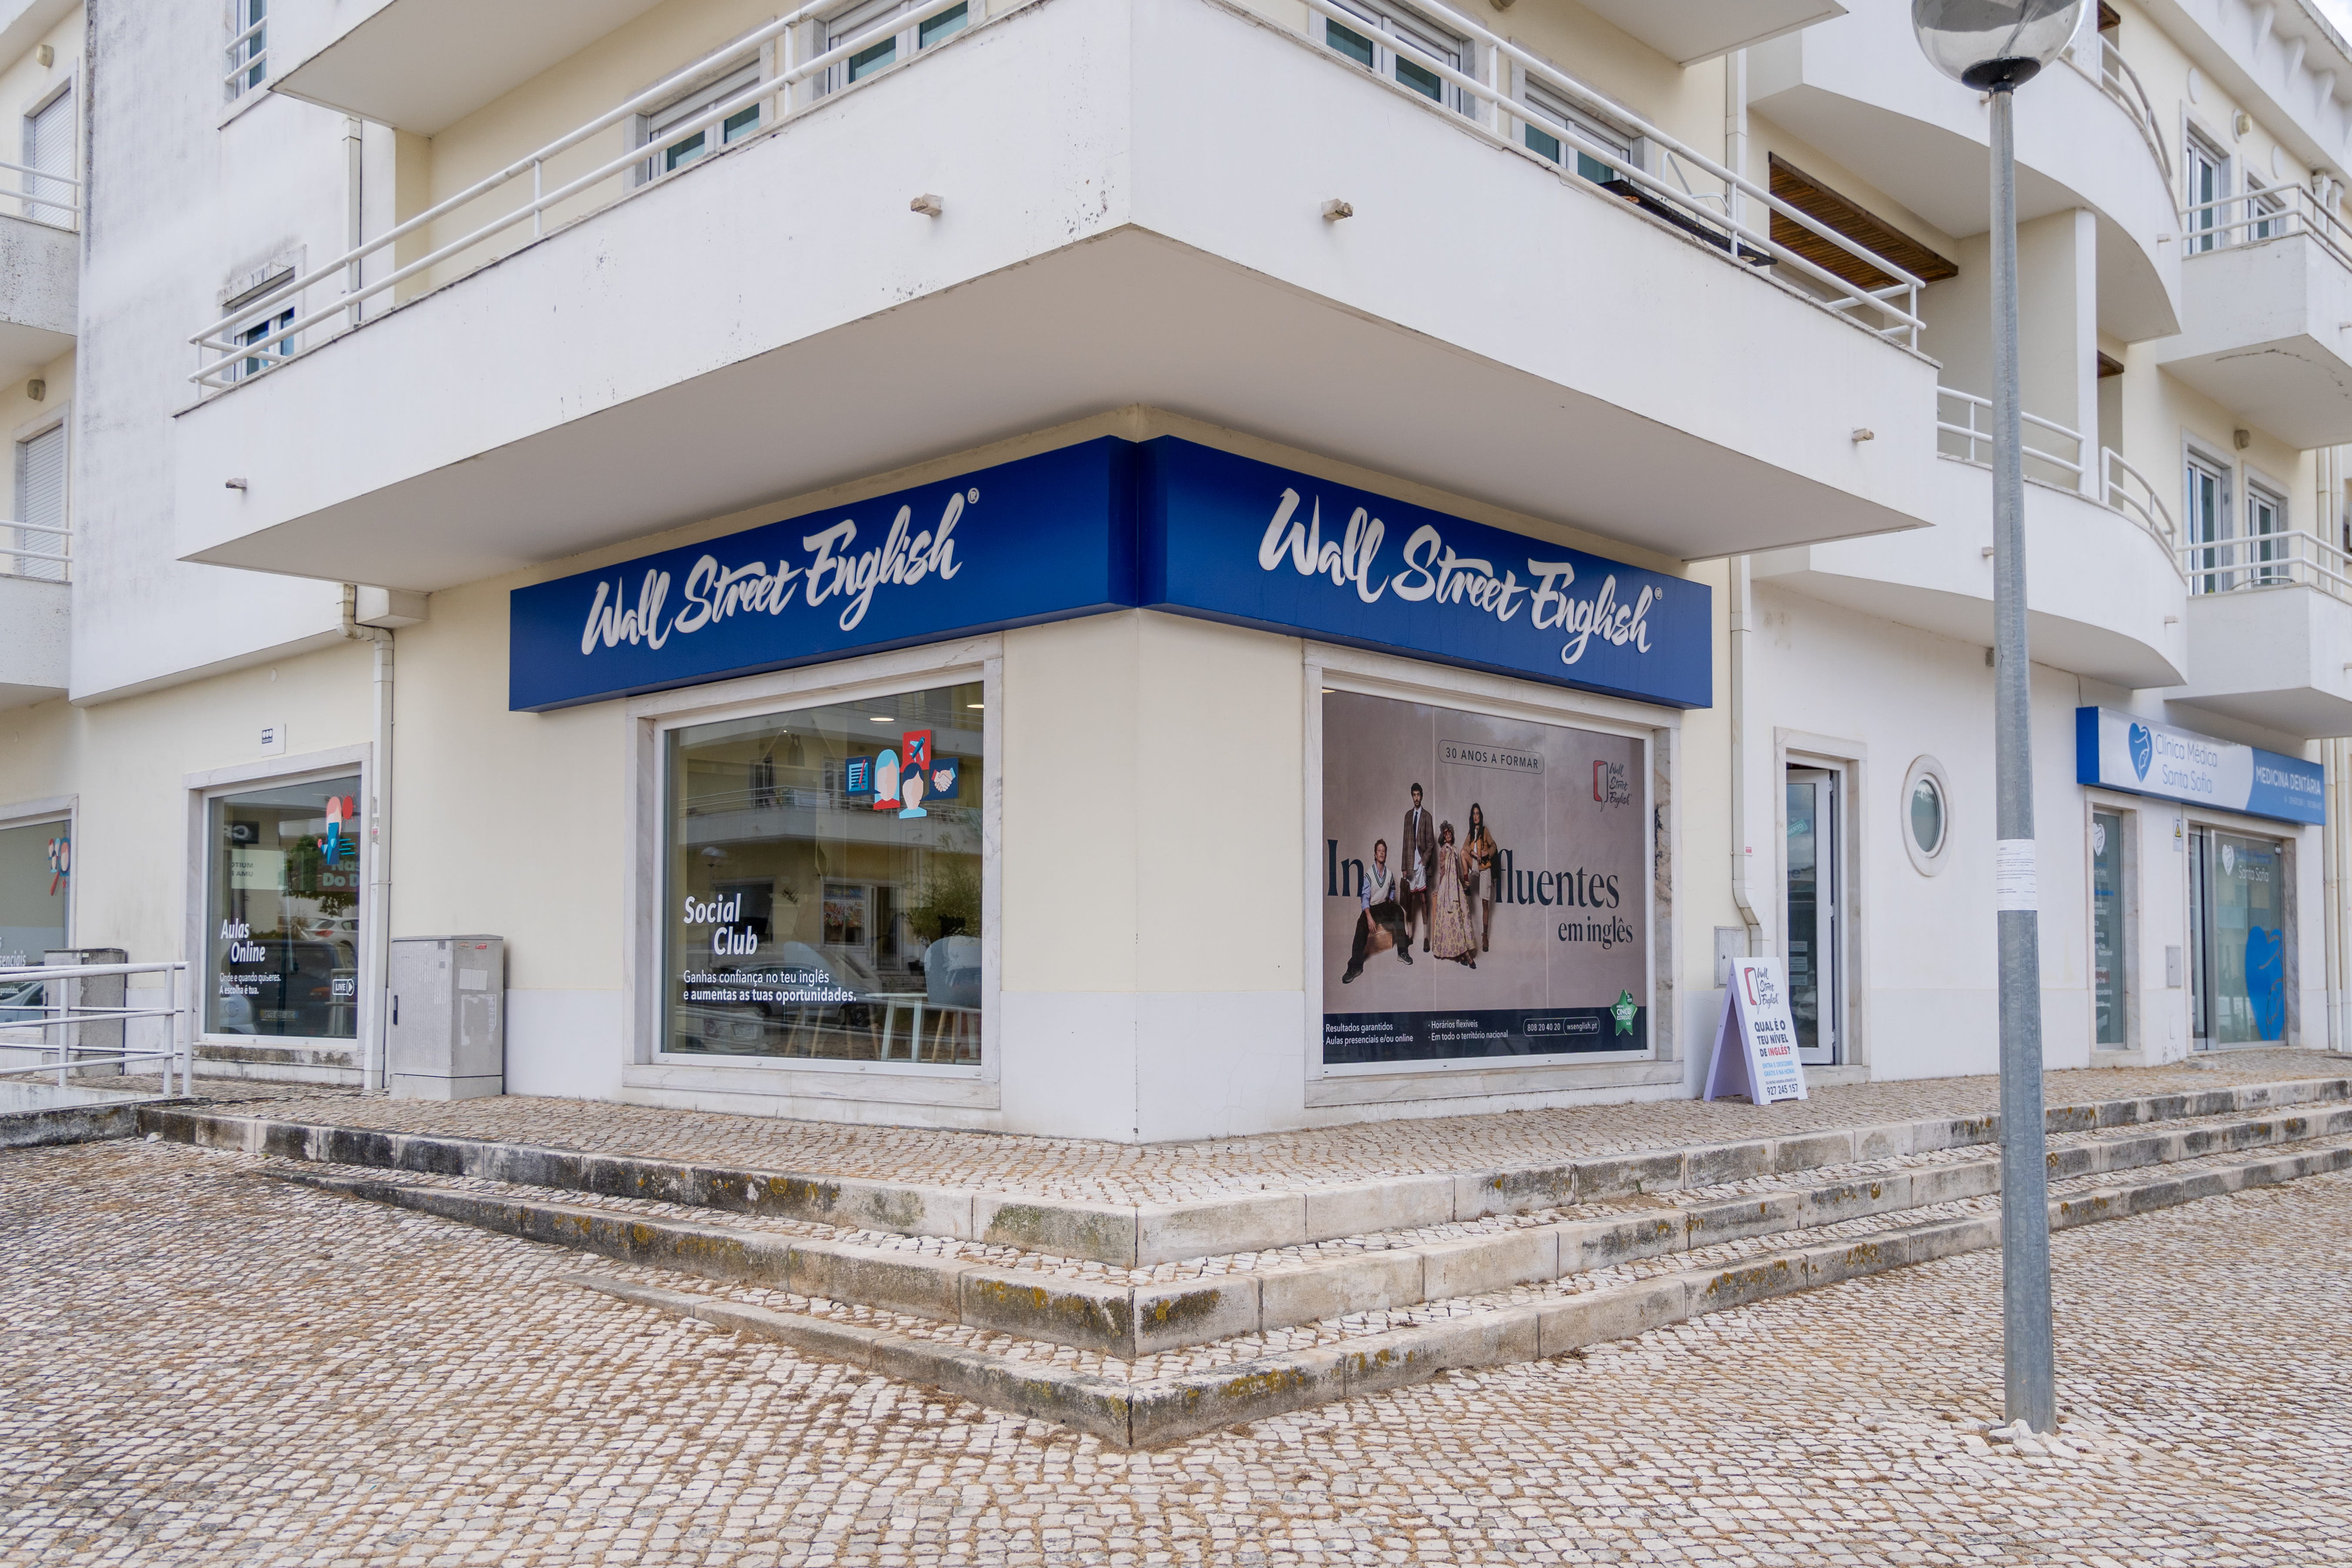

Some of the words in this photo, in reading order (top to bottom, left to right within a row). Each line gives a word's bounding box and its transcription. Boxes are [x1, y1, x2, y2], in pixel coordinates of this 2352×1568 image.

[1258, 487, 1389, 603] Wall
[1391, 524, 1530, 622] Street
[581, 569, 674, 655] Wall
[674, 554, 805, 634] Street
[1446, 747, 1457, 759] 30
[1461, 750, 1487, 763] ANOS
[1491, 754, 1497, 764] A
[1501, 755, 1538, 769] FORMAR
[2155, 734, 2185, 759] Clínica
[2187, 741, 2217, 767] Médica
[1609, 762, 1624, 777] Wall
[1609, 776, 1628, 791] Street
[2162, 764, 2188, 789] Santa
[2191, 770, 2212, 794] Sofia
[2255, 765, 2289, 788] MEDICINA
[2290, 774, 2321, 795] DENTÁRIA
[1787, 823, 1803, 836] BERTO
[323, 873, 346, 887] Do
[1327, 839, 1364, 897] In
[1495, 848, 1619, 908] fluentes
[2239, 865, 2254, 880] Santa
[2255, 867, 2269, 882] Sofia
[684, 893, 741, 924] Social
[220, 918, 250, 939] Aulas
[1558, 921, 1583, 942] em
[1587, 915, 1633, 950] inglês
[714, 925, 757, 955] Club
[231, 941, 266, 963] Online
[220, 972, 234, 982] Onde
[238, 971, 257, 984] quando
[683, 969, 717, 984] Ganhas
[719, 969, 763, 986] confiança
[766, 974, 778, 984] no
[781, 971, 796, 984] teu
[799, 969, 829, 987] inglês
[1757, 967, 1768, 979] Wall
[219, 985, 224, 994] A
[224, 984, 244, 994] escolha
[244, 984, 248, 994] é
[249, 985, 259, 994] tua.
[1760, 980, 1774, 992] Street
[684, 991, 689, 1000] e
[691, 989, 737, 1001] aumentas
[739, 990, 750, 1001] as
[752, 988, 773, 1001] tuas
[776, 987, 857, 1004] oportunidades.
[1326, 1023, 1360, 1032] Resultados
[1361, 1022, 1393, 1033] garantidos
[1431, 1020, 1455, 1029] Horários
[1456, 1020, 1478, 1028] flexíveis
[1567, 1022, 1597, 1031] wsenglish.pt
[1755, 1021, 1774, 1032] QUAL
[1775, 1018, 1779, 1031] É
[1780, 1020, 1785, 1030] O
[1326, 1036, 1343, 1045] Aulas
[1344, 1035, 1378, 1046] presenciais
[1380, 1034, 1394, 1043] e/ou
[1395, 1034, 1413, 1042] online
[1442, 1032, 1455, 1040] todo
[1461, 1031, 1485, 1039] território
[1486, 1030, 1508, 1038] nacional
[1757, 1035, 1768, 1045] TEU
[1770, 1031, 1788, 1044] NÍVEL
[1760, 1048, 1767, 1057] DE
[1768, 1045, 1790, 1056] INGLÊS?
[1767, 1086, 1776, 1096] 927
[1778, 1085, 1788, 1094] 245
[1789, 1084, 1798, 1093] 157
